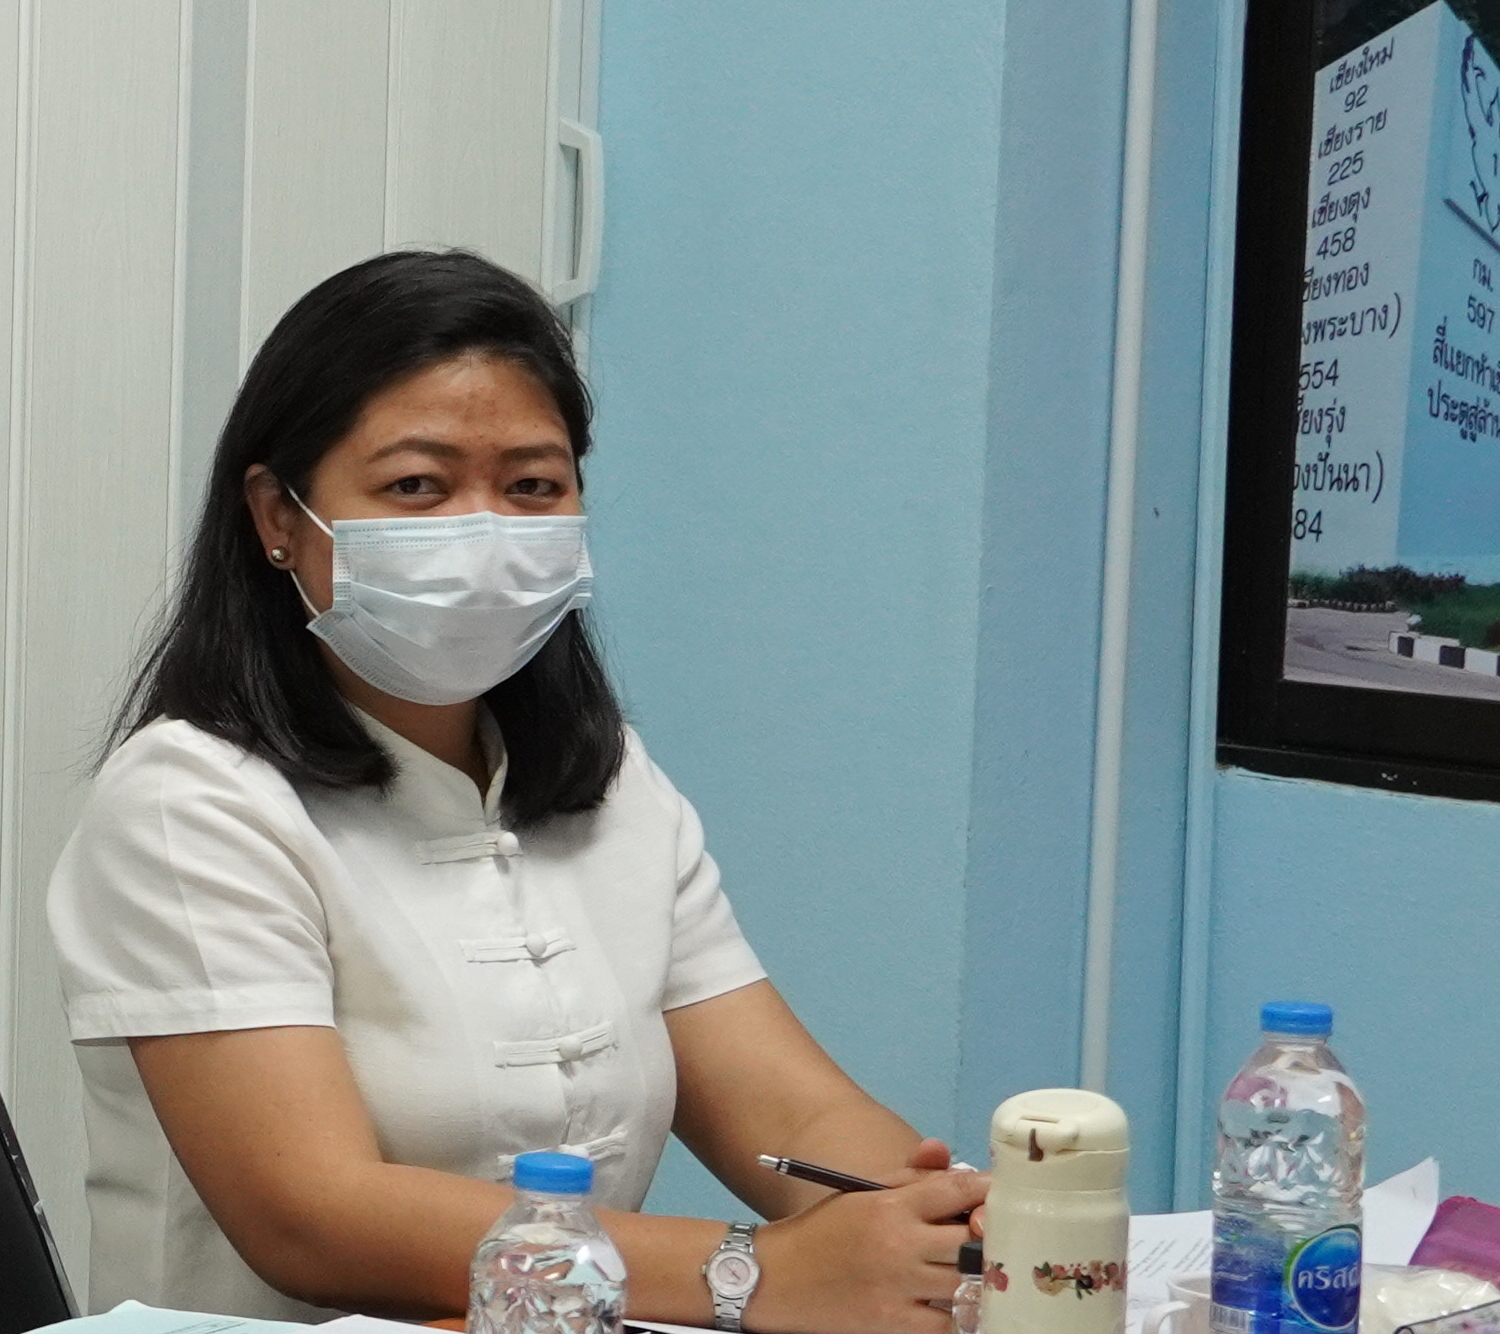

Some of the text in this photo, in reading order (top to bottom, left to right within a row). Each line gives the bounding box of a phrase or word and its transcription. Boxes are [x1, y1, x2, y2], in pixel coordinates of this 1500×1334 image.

[1344, 84, 1369, 113] 92
[1318, 108, 1388, 159] เชียงราย
[1327, 150, 1365, 186] 225
[1316, 226, 1357, 260] 458
[1302, 262, 1371, 302] ชียงทอง
[1467, 294, 1495, 334] 597
